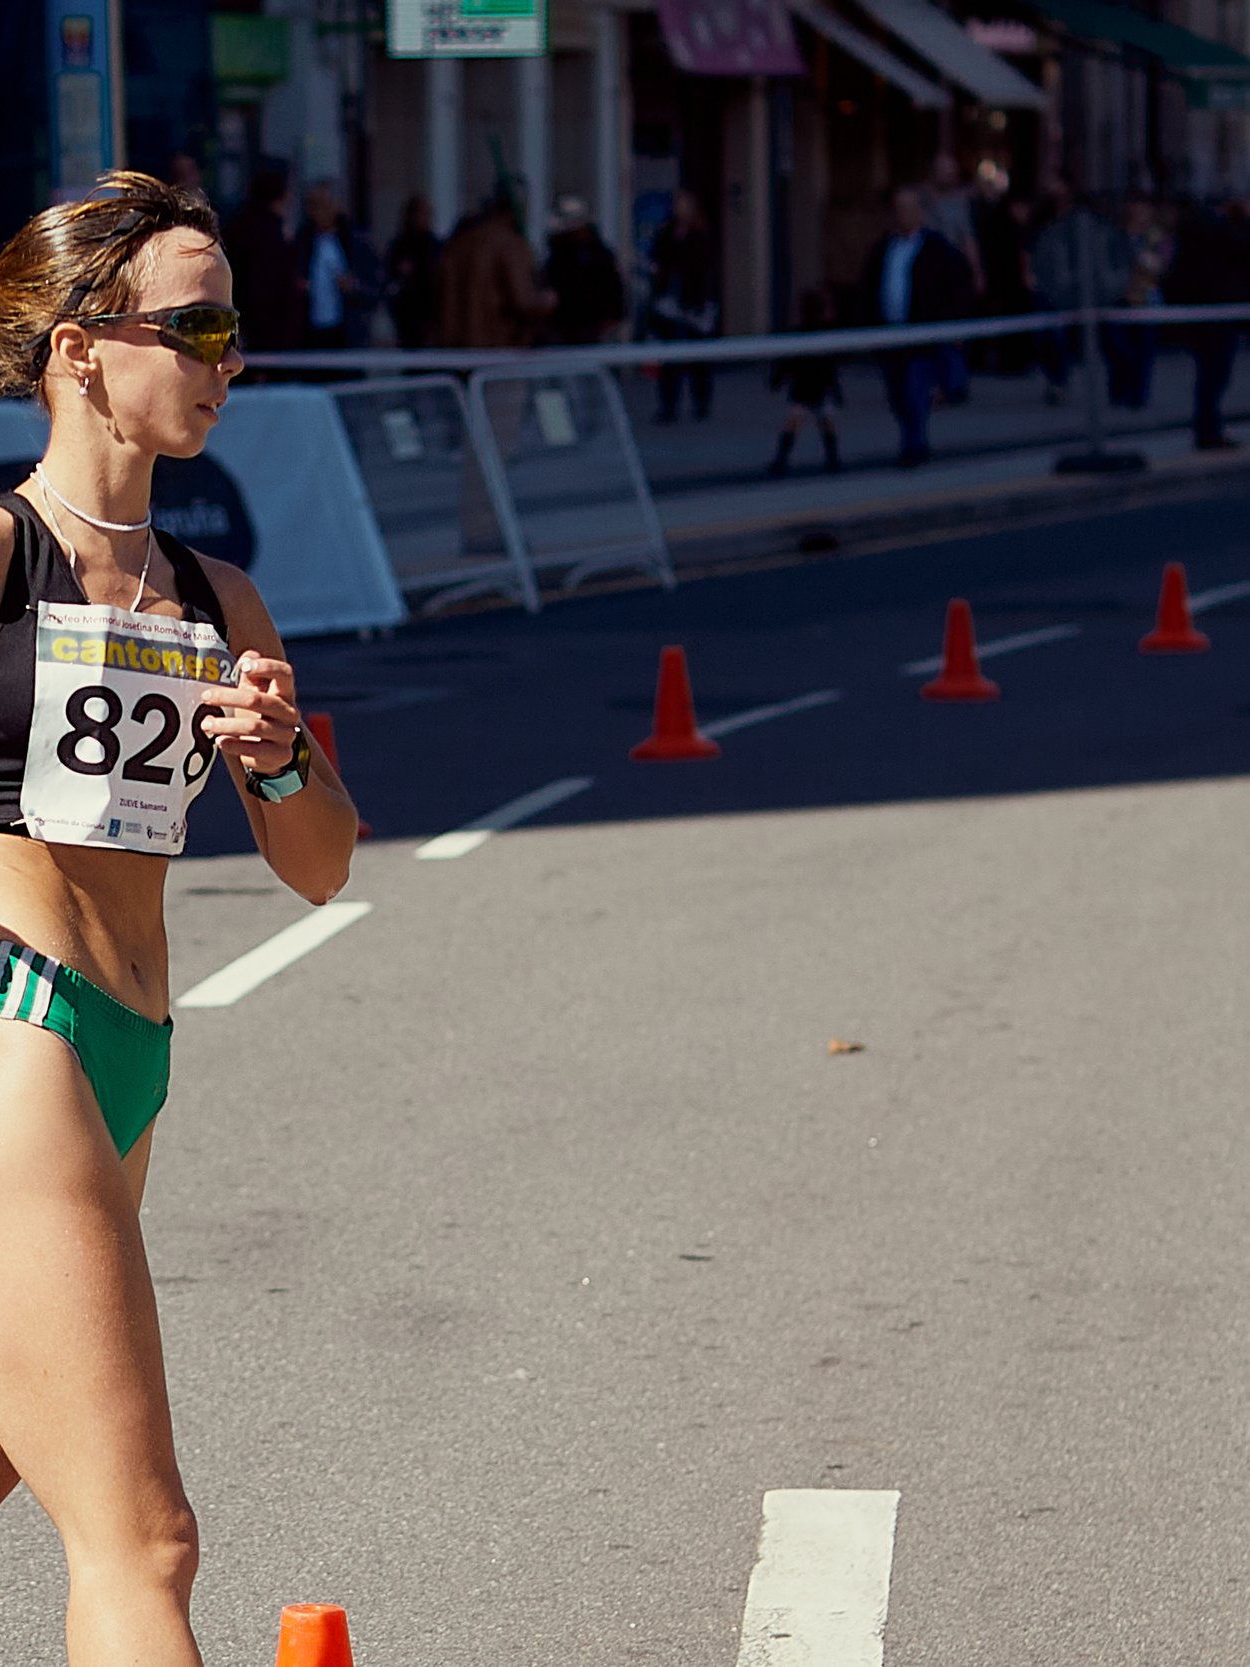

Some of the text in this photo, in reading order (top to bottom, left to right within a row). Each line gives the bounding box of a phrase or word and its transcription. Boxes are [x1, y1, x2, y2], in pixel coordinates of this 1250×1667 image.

[121, 620, 152, 632] Josefina
[183, 630, 192, 641] de
[139, 800, 168, 812] Samanta
